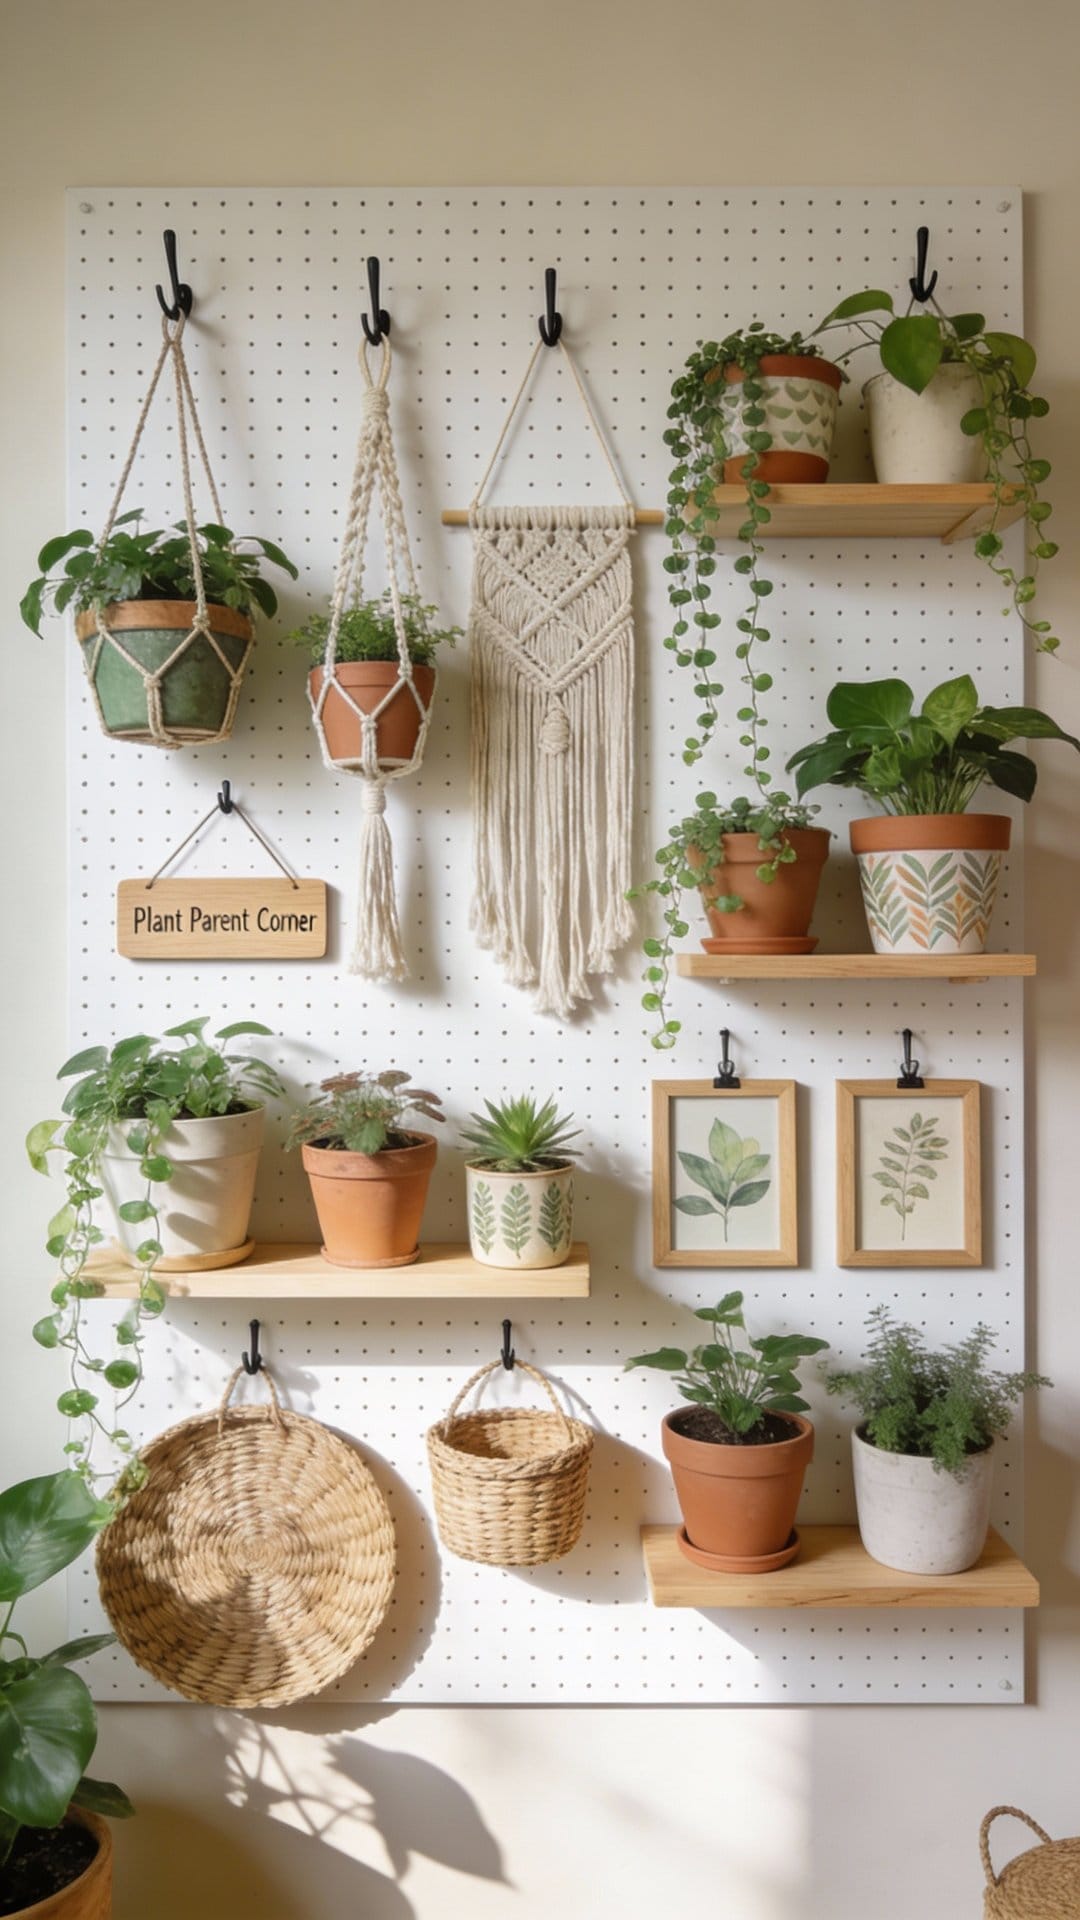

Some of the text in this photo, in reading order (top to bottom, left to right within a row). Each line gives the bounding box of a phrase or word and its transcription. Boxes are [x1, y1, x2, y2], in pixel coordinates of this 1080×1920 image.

[134, 906, 317, 934] Plant Parent Corner
